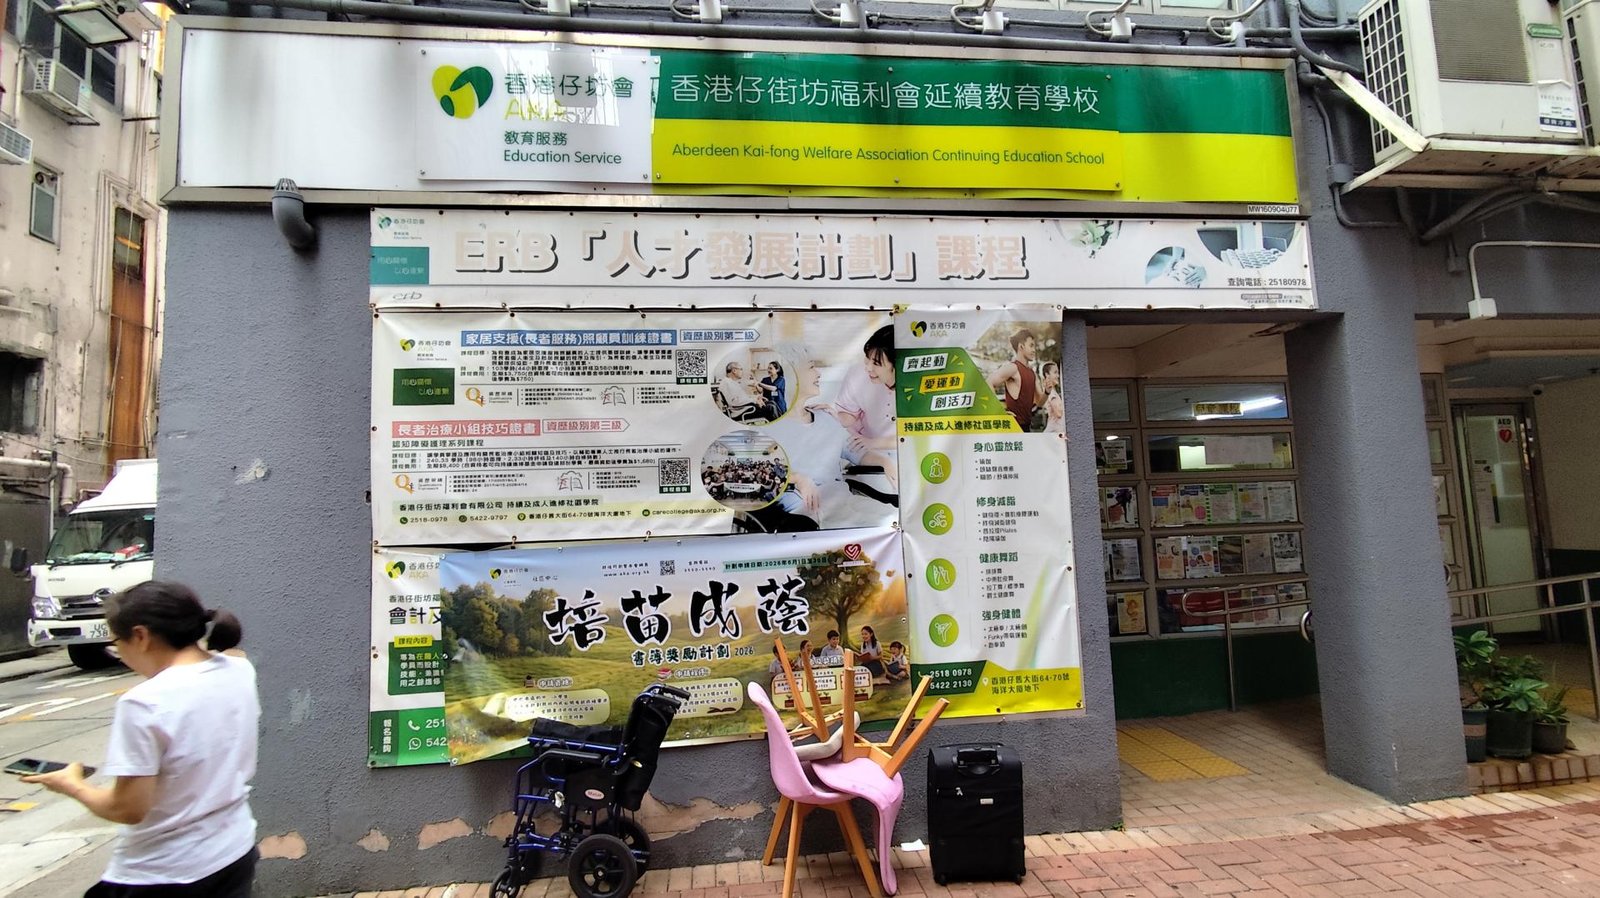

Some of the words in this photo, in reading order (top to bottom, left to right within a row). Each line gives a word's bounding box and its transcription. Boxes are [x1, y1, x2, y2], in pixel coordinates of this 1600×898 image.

[671, 74, 1101, 115] 香港仔街坊福利會延續教育學校
[504, 131, 568, 146] 教育服務
[503, 149, 571, 164] Education
[574, 151, 622, 165] Service
[672, 143, 740, 157] Aberdeen
[744, 144, 800, 161] Kai-fong
[804, 145, 853, 160] Welfare
[856, 147, 930, 161] Association
[933, 148, 1001, 165] Continuing
[1004, 149, 1063, 164] Education
[1066, 151, 1105, 165] School
[456, 232, 558, 273] ERB
[582, 229, 917, 283] 「人才發展計劃」
[936, 232, 1030, 281] 課程
[1268, 278, 1307, 286] 25180978
[466, 332, 673, 347] 家居支援(長者服務)照顧員訓練證書
[682, 331, 754, 341] 資歷級別第二級
[907, 356, 945, 369] 齊起動
[924, 375, 961, 389] 愛運動
[935, 394, 972, 408] 創活力
[398, 423, 536, 436] 長者治療小組技巧證書
[547, 421, 622, 431] 資歷級別第三級
[904, 419, 1011, 432] 持續及成人進修社區學院
[973, 440, 1024, 453] 身心靈放鬆
[976, 496, 1016, 507] 修身減脂
[979, 551, 1018, 564] 健康舞蹈
[545, 575, 809, 648] 培苗成蔭
[982, 608, 1021, 620] 強身健體
[633, 643, 731, 666] 書簿獎勵計劃
[734, 646, 755, 657] 2026
[930, 669, 950, 678] 2518
[952, 668, 972, 677] 0978
[930, 681, 950, 690] 5422
[952, 679, 972, 689] 2130
[425, 718, 446, 729] 251
[426, 737, 448, 749] 542
